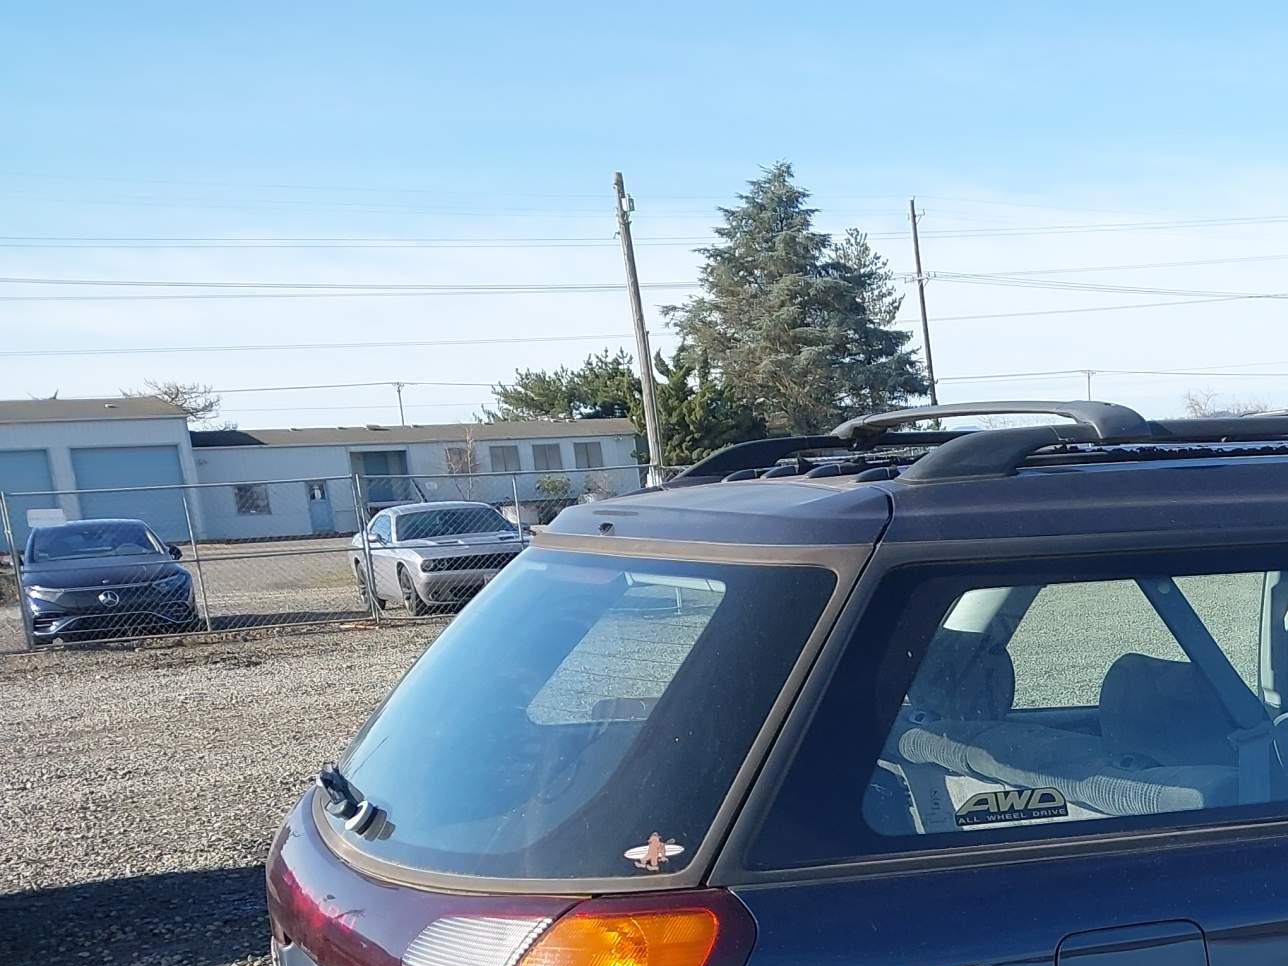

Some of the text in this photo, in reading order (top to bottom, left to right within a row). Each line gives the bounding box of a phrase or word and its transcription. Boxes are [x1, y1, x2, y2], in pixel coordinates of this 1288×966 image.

[956, 789, 1065, 816] AWD
[986, 813, 1027, 821] WHEEL
[1033, 808, 1065, 816] DRIVE
